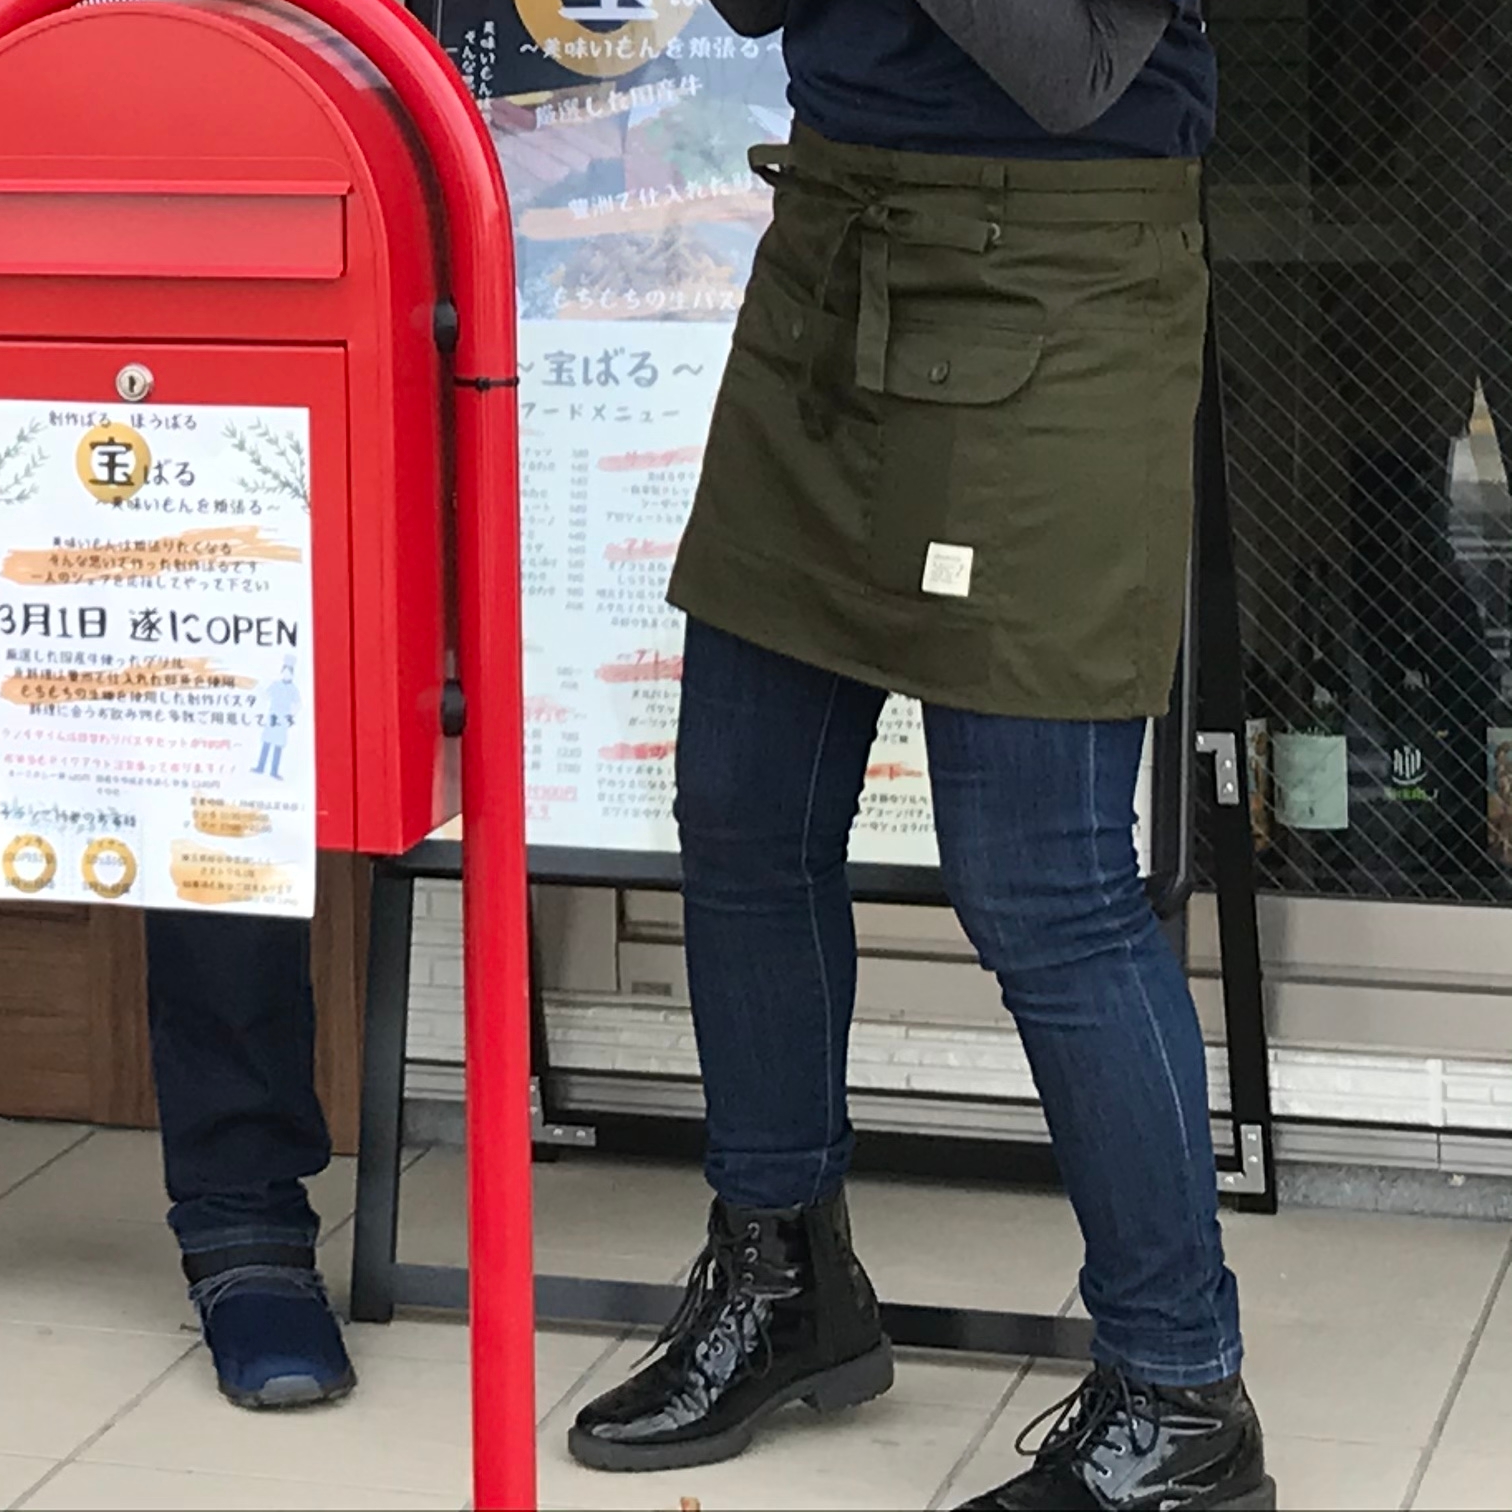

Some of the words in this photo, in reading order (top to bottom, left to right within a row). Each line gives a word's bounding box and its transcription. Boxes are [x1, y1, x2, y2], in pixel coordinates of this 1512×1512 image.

[48, 410, 112, 430] 創作ばる
[130, 413, 197, 431] ほうばる
[128, 606, 299, 648] 遂にOPEN
